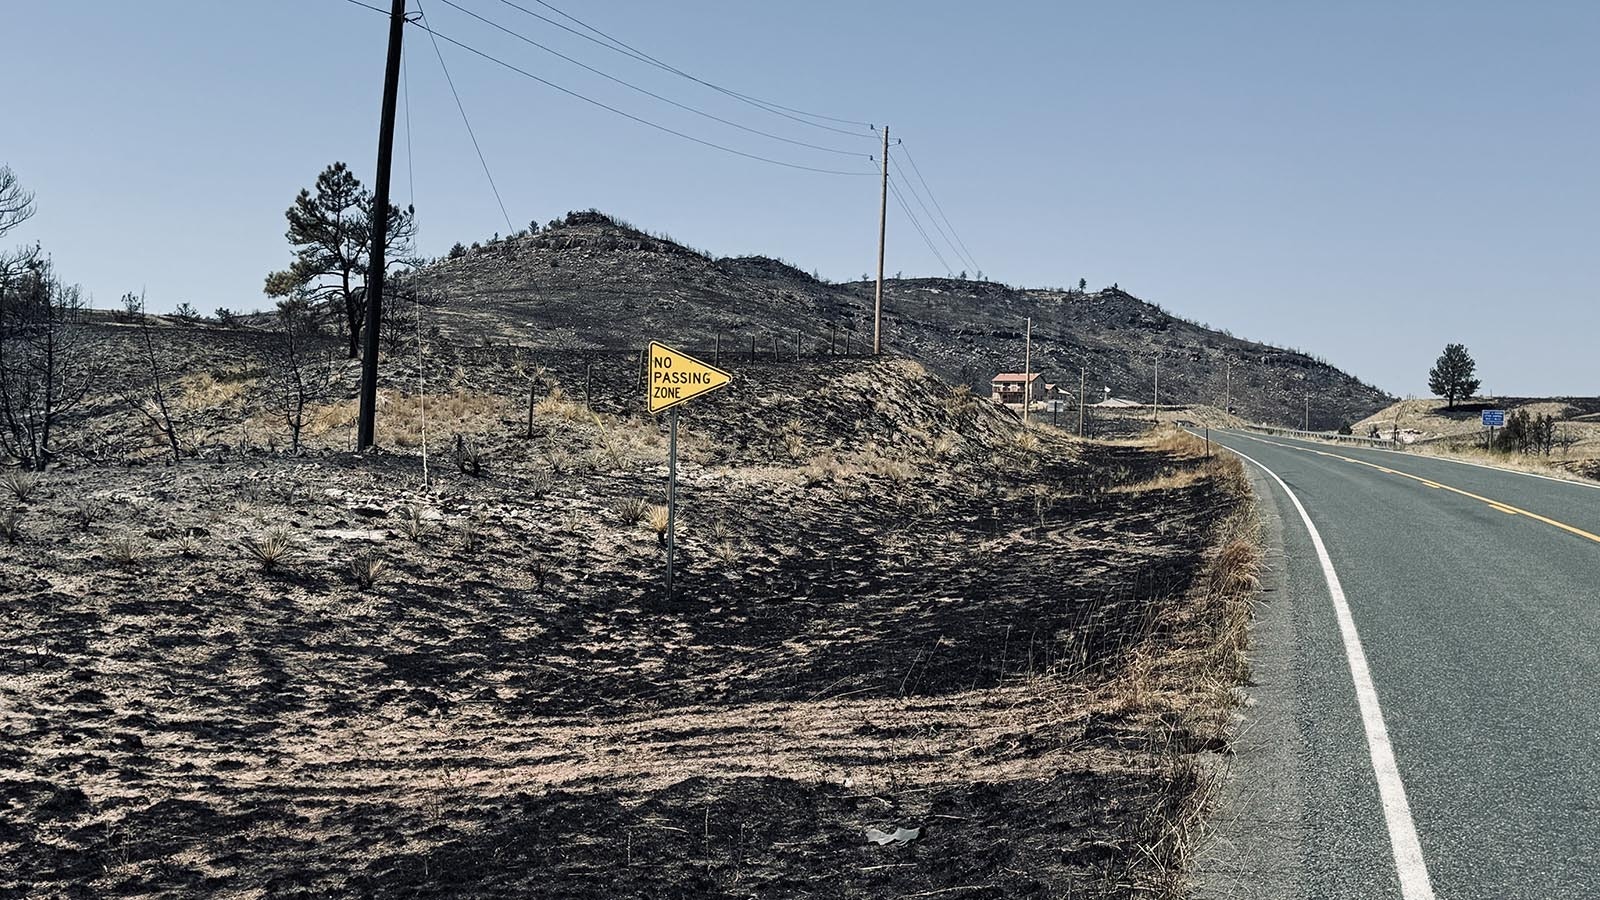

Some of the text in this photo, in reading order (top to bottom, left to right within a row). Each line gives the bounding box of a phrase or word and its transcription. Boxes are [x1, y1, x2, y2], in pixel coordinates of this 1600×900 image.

[654, 357, 672, 368] NO
[654, 372, 711, 384] PASSING
[653, 387, 681, 399] ZONE
